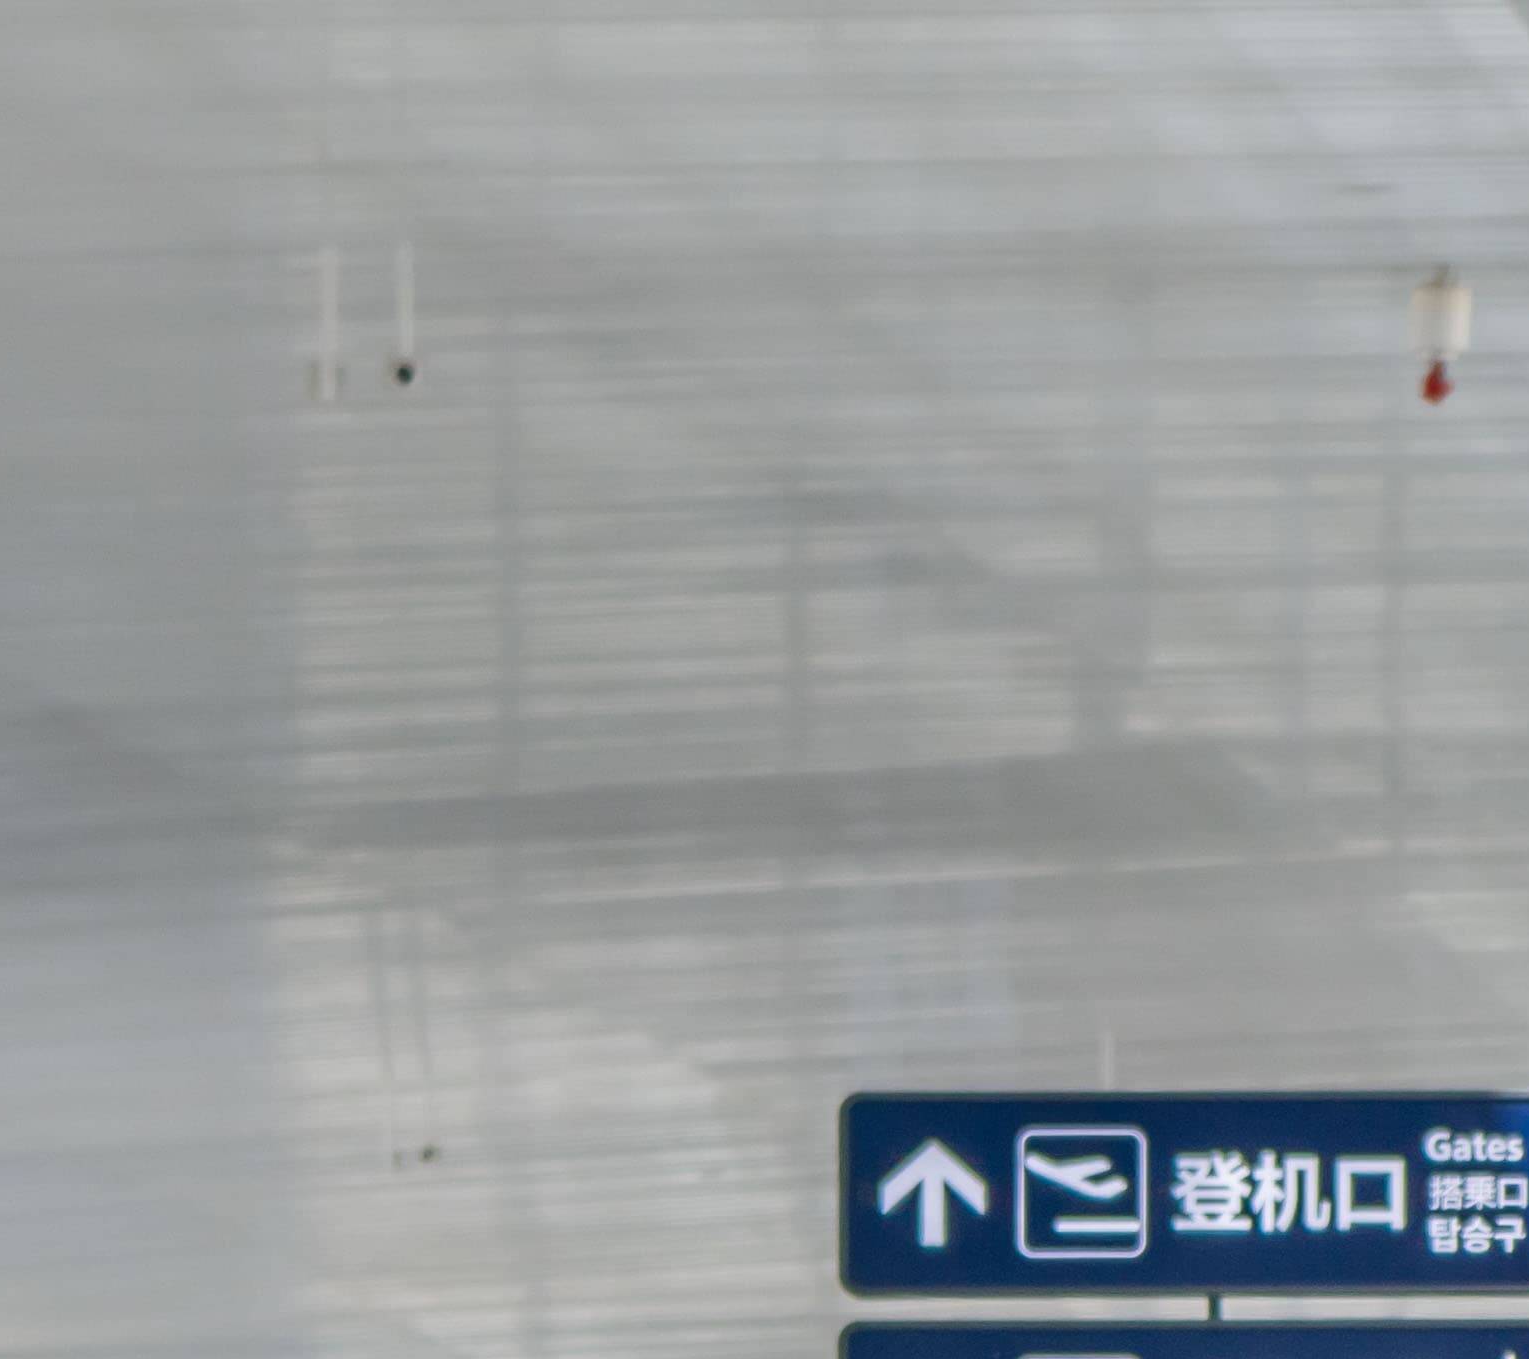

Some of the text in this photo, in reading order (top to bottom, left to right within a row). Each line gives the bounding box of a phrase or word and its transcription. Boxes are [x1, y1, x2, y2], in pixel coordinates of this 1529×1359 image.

[1425, 1129, 1524, 1161] Gates
[1172, 1152, 1407, 1234] 登机口
[1427, 1215, 1527, 1254] 탑승구
